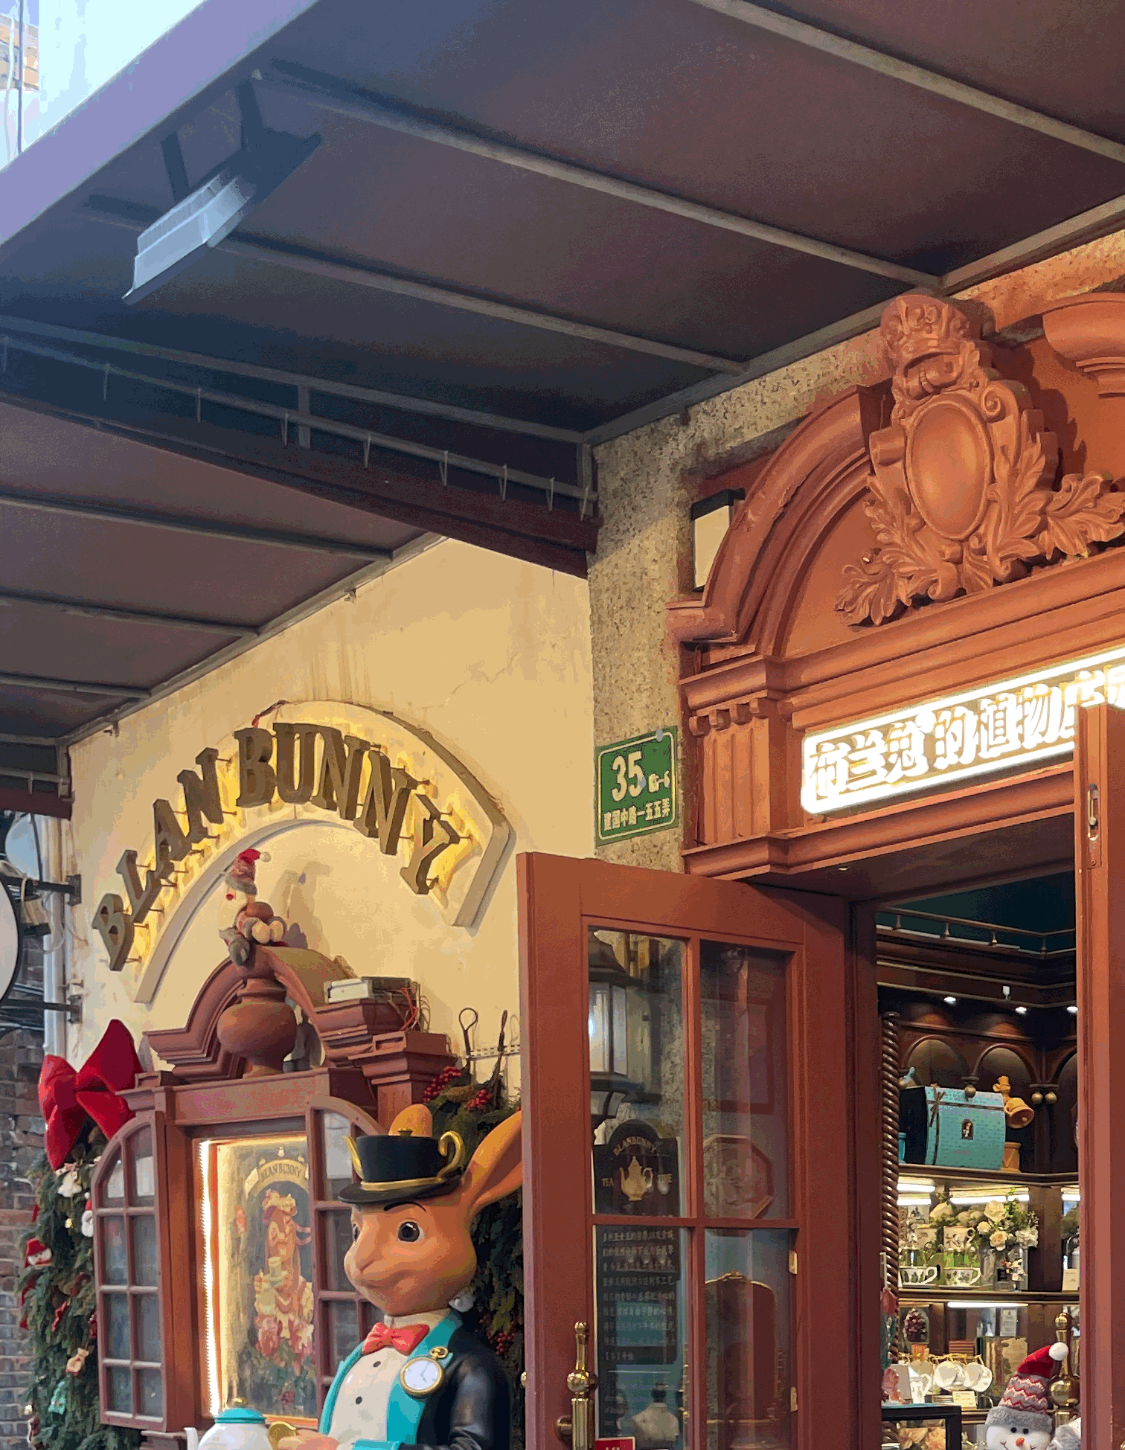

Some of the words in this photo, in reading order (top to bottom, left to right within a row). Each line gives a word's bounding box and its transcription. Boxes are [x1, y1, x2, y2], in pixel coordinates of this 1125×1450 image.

[611, 750, 647, 802] 35
[92, 747, 224, 971] BLAN
[234, 722, 461, 895] BUNNY
[601, 1177, 614, 1187] TEA
